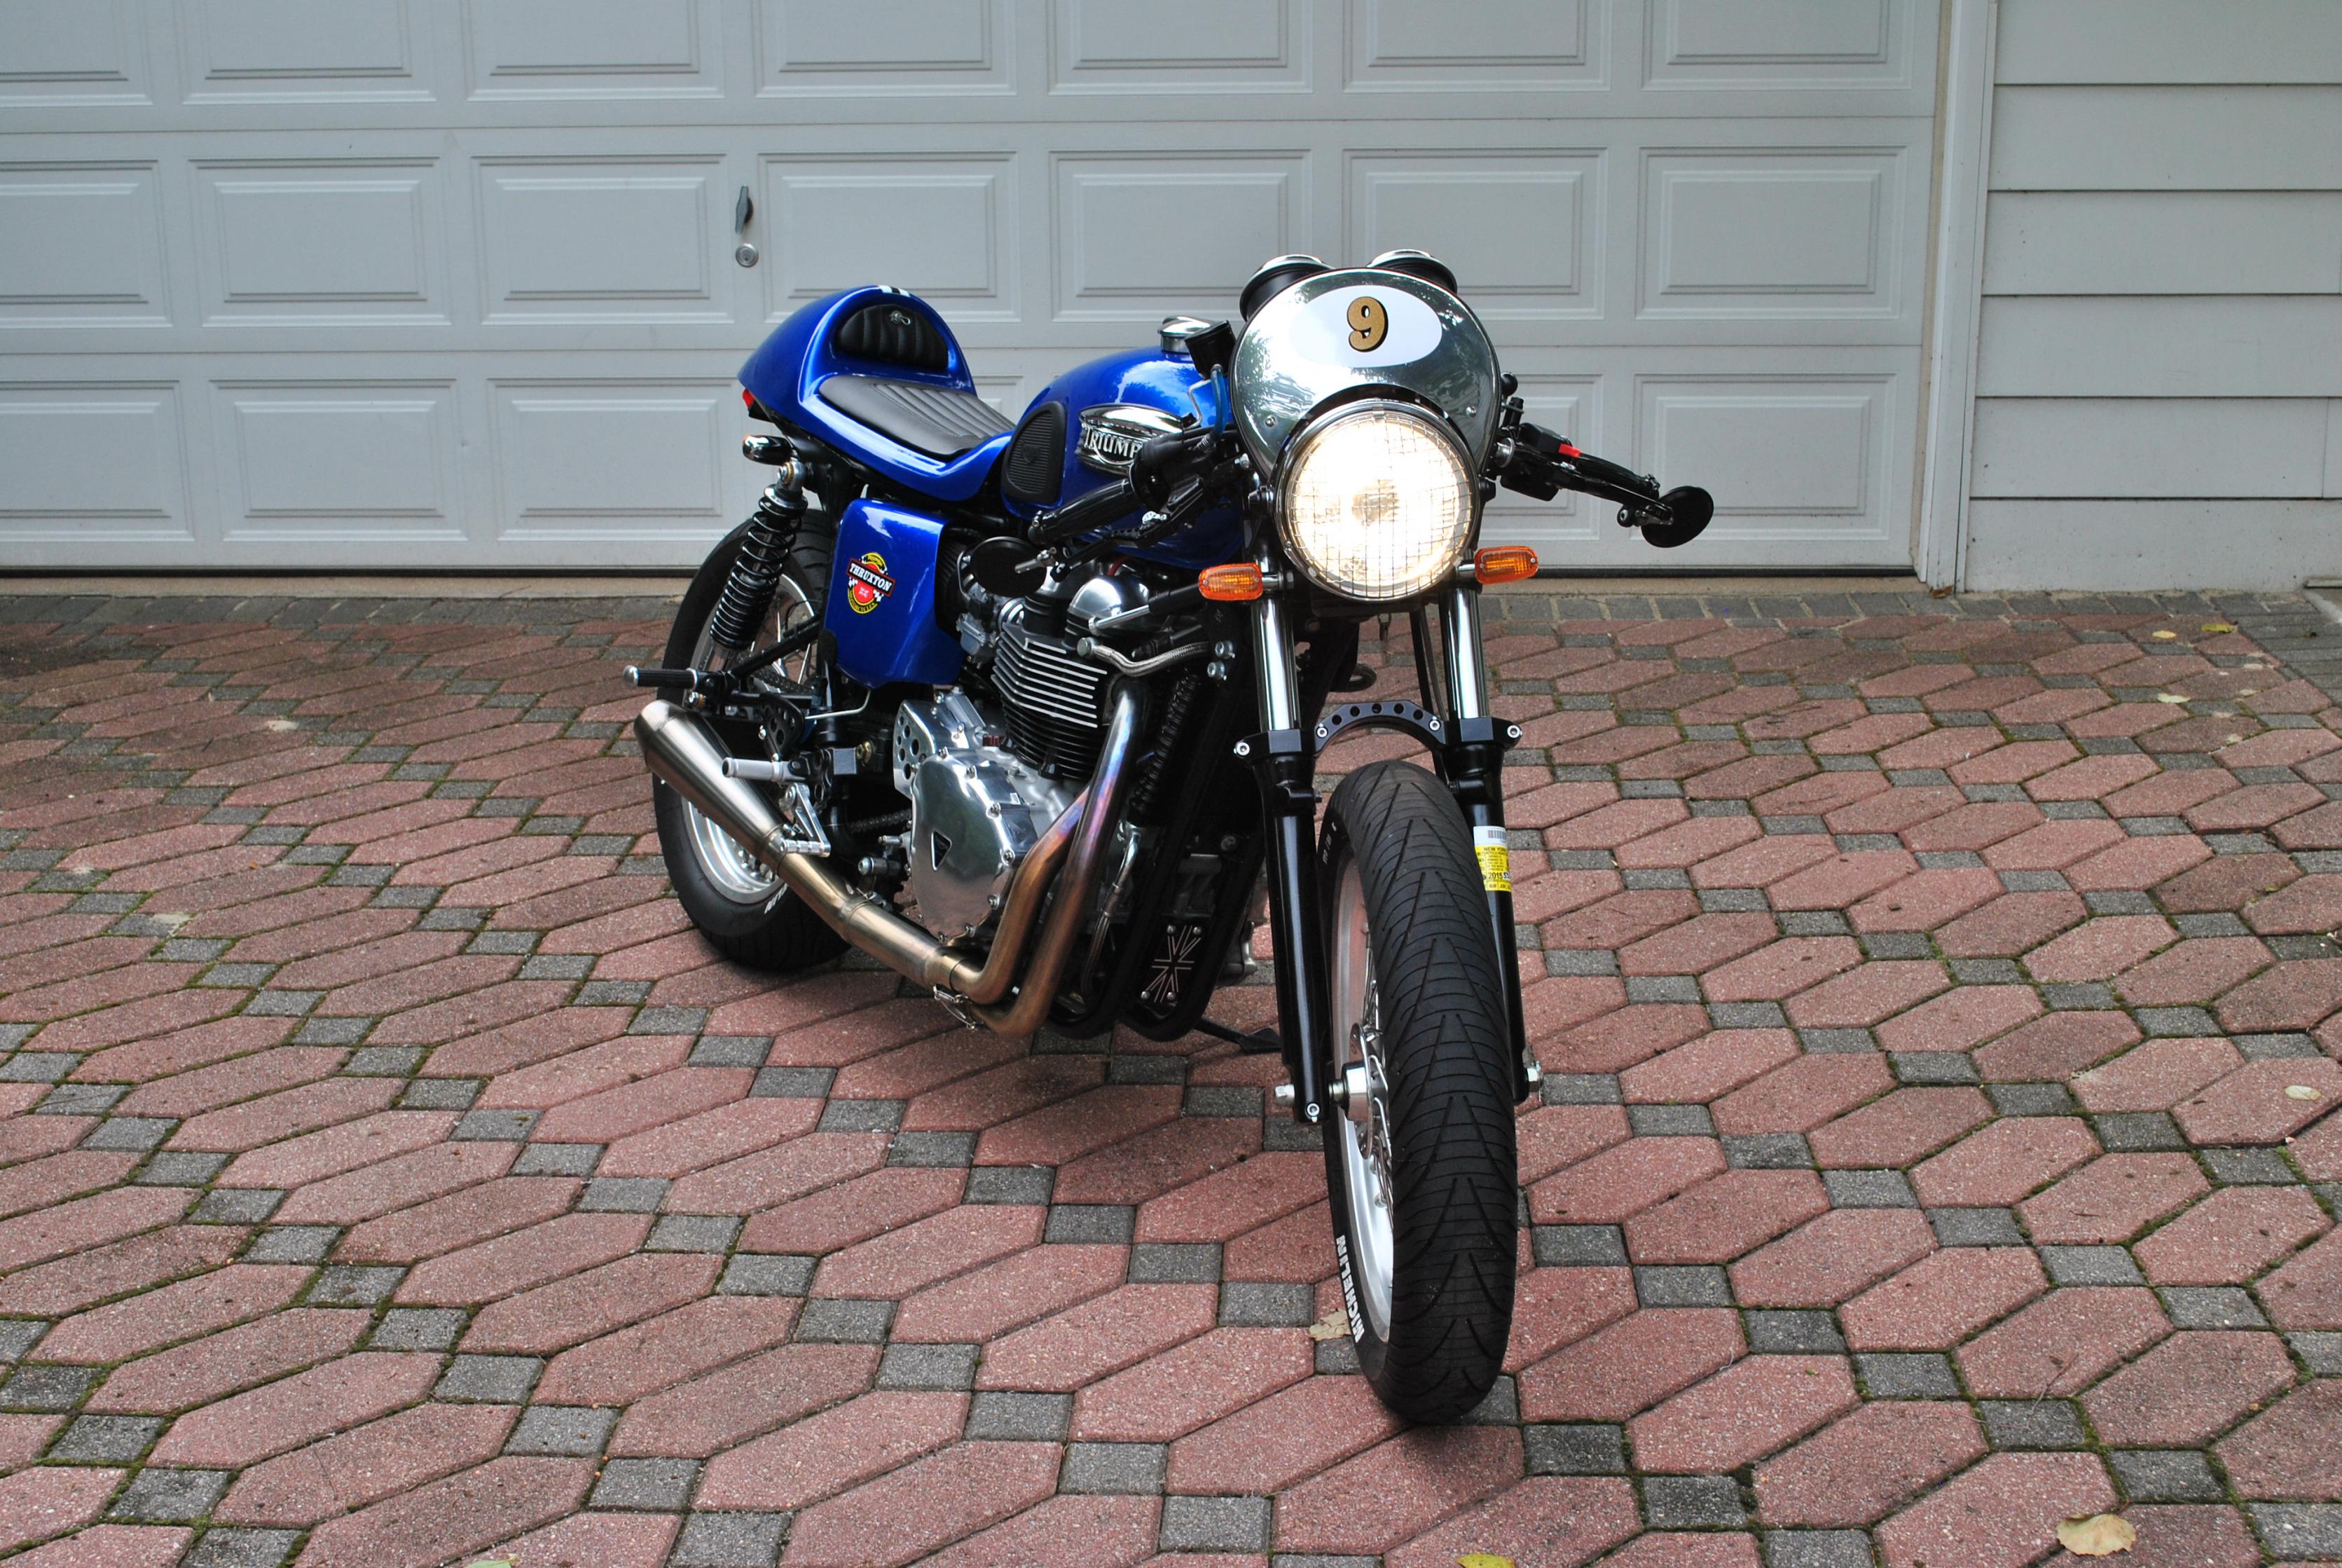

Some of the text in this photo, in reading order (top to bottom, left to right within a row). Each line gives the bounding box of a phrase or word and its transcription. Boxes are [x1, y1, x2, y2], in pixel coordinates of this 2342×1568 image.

[1346, 296, 1389, 352] 9
[1082, 425, 1143, 458] TRIUMP
[849, 563, 893, 591] THRUXTON
[1488, 872, 1503, 880] 2015
[1336, 1235, 1365, 1343] MICHELIN
